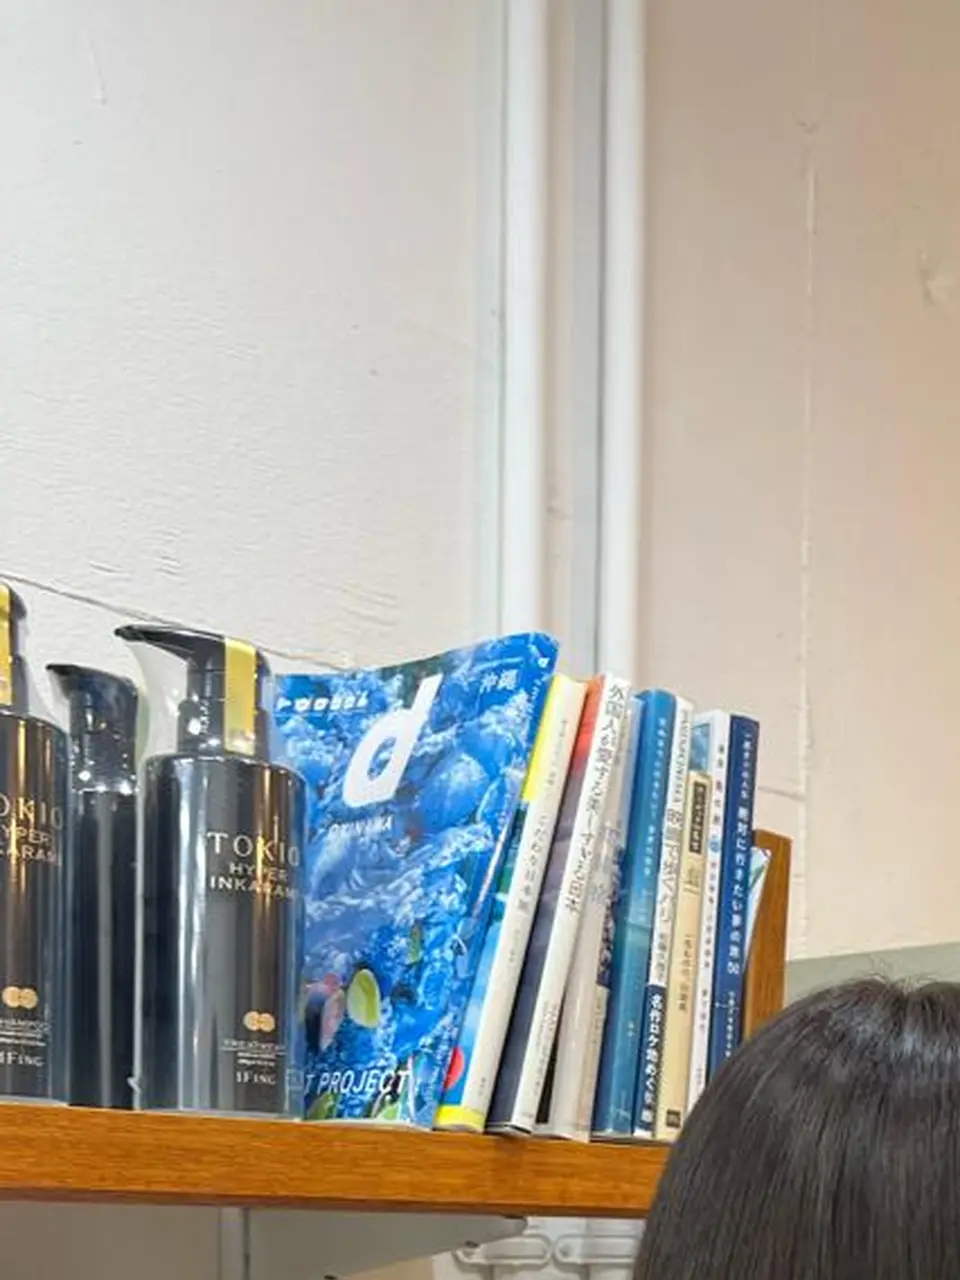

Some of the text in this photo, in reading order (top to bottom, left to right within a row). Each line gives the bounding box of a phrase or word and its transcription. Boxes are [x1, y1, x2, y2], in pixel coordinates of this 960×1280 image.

[342, 672, 445, 808] d
[207, 832, 299, 867] TOKIO
[317, 1068, 411, 1095] PROJECT
